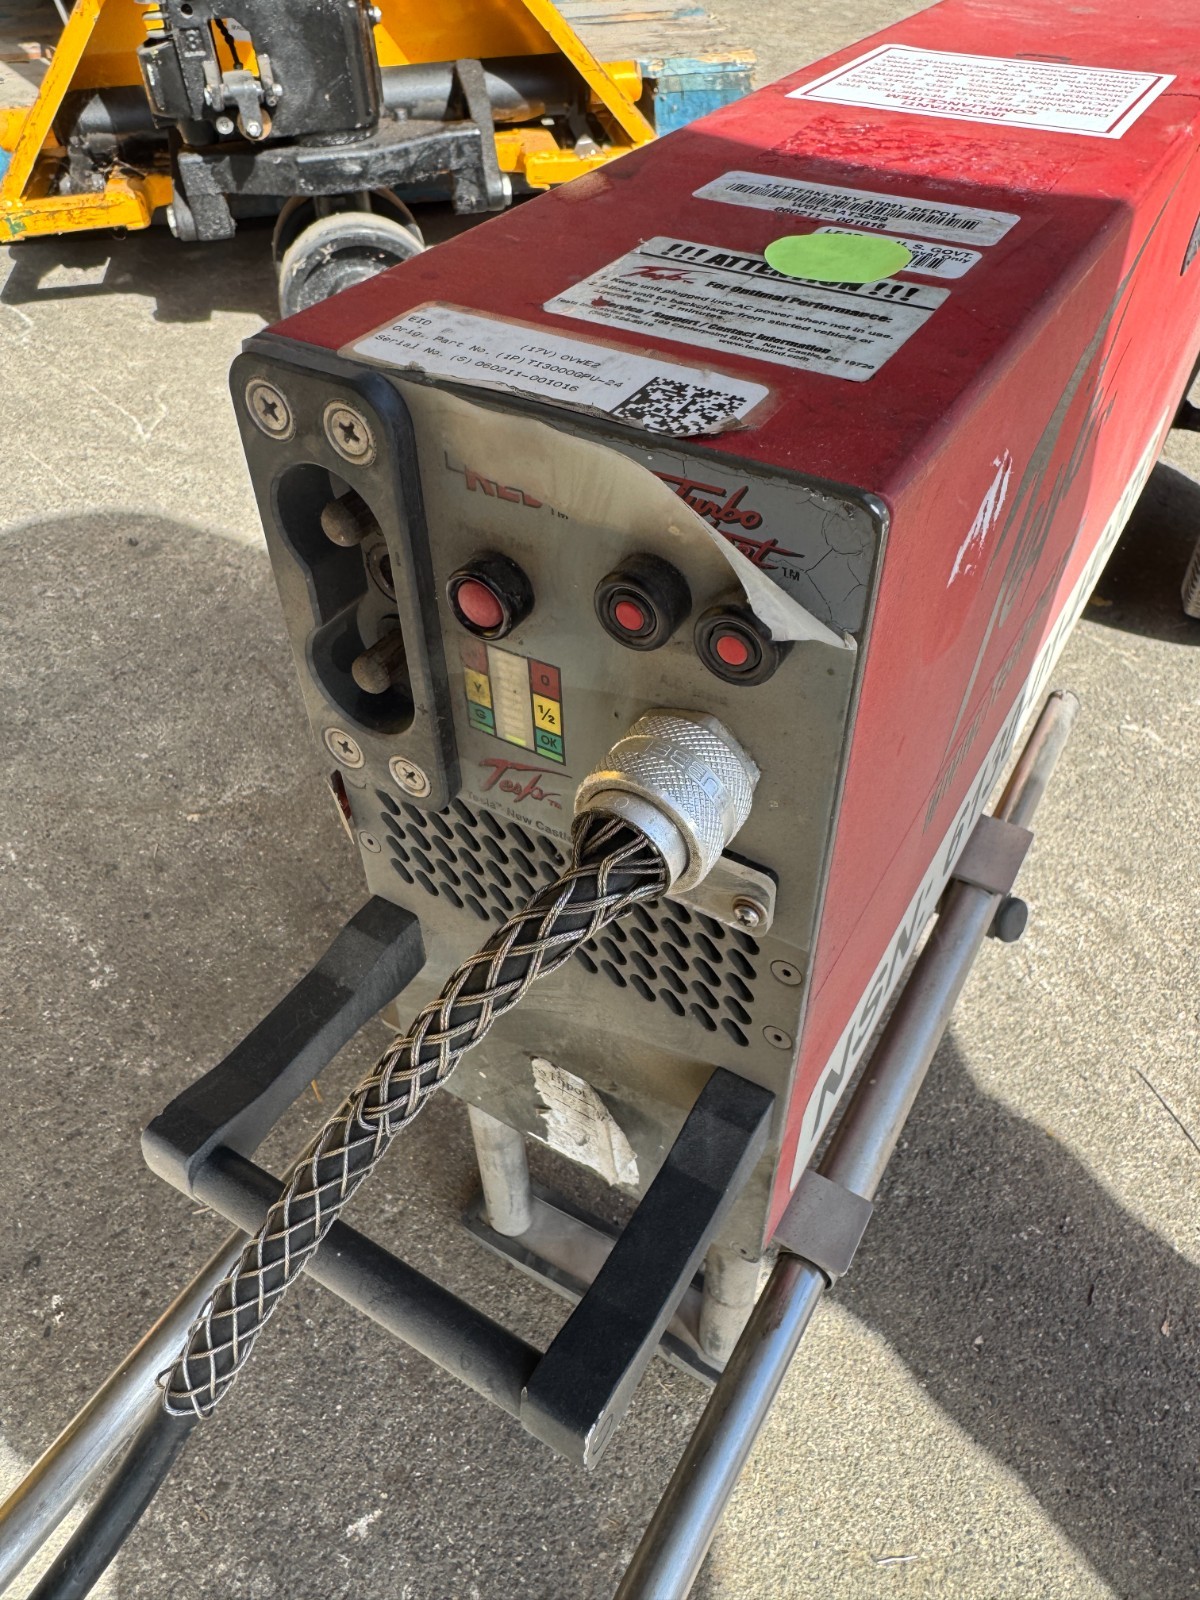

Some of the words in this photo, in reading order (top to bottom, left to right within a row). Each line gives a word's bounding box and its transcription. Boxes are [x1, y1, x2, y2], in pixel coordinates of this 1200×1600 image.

[883, 93, 925, 101] ITEM
[925, 98, 1037, 115] COMPLIANCE
[763, 183, 862, 203] LETTERKENNY
[863, 198, 908, 210] ARMY
[909, 206, 959, 218] DEPOT
[929, 247, 973, 258] GOVT.
[940, 254, 970, 263] Only
[608, 278, 640, 287] Keep
[637, 283, 664, 292] unit
[660, 288, 711, 302] plugged
[709, 298, 737, 307] into
[752, 307, 793, 318] power
[793, 315, 828, 326] when
[827, 322, 852, 330] not
[866, 330, 896, 339] use.
[631, 296, 652, 304] for
[703, 281, 731, 290] For
[727, 285, 789, 302] Optimal
[786, 297, 895, 323] Performance:
[405, 315, 434, 326] EID
[599, 284, 631, 293] Allow
[631, 290, 656, 298] unit
[668, 298, 738, 316] backcharge
[736, 312, 767, 322] from
[766, 318, 812, 331] started
[811, 327, 861, 341] vehicle
[650, 311, 701, 326] Support
[706, 323, 757, 338] Contact
[754, 333, 833, 354] Information
[372, 334, 420, 349] Serial
[421, 347, 448, 357] No.
[430, 335, 466, 347] Part
[467, 345, 493, 354] No.
[473, 682, 482, 693] Y
[475, 708, 487, 720] G
[537, 704, 556, 725] 1/2
[540, 734, 557, 749] OK
[506, 808, 533, 827] New
